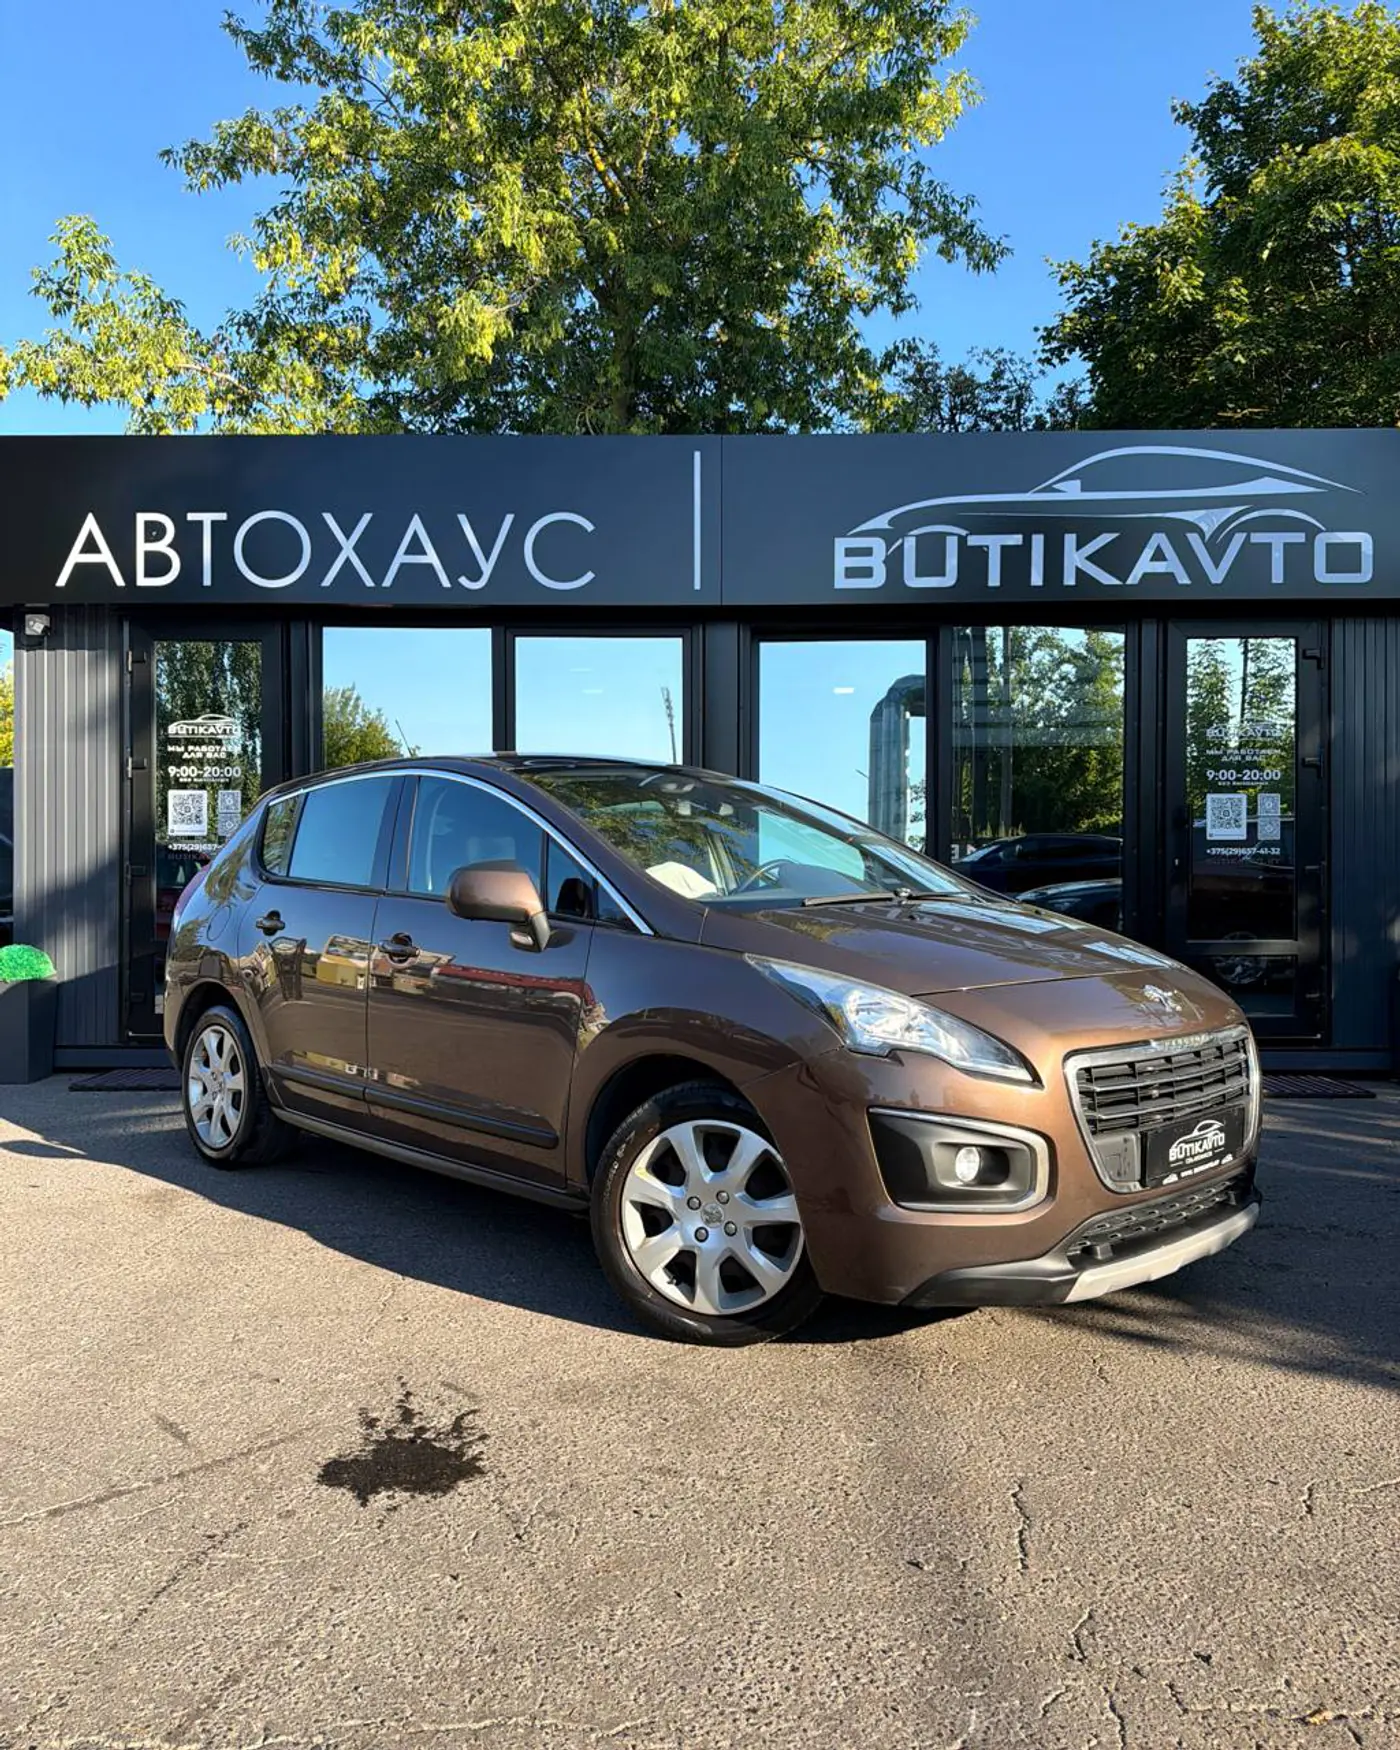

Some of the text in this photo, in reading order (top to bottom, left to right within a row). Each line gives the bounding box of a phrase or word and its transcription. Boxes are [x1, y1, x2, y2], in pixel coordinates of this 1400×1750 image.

[56, 510, 596, 590] АВТОХАУС
[833, 531, 1374, 589] BUTIKAVTO
[168, 725, 240, 735] BUTIKAVTO
[167, 766, 241, 777] 9:00-20:00
[1206, 769, 1281, 780] 9:00-20:00
[1168, 1131, 1225, 1162] BUTIKAVTO
